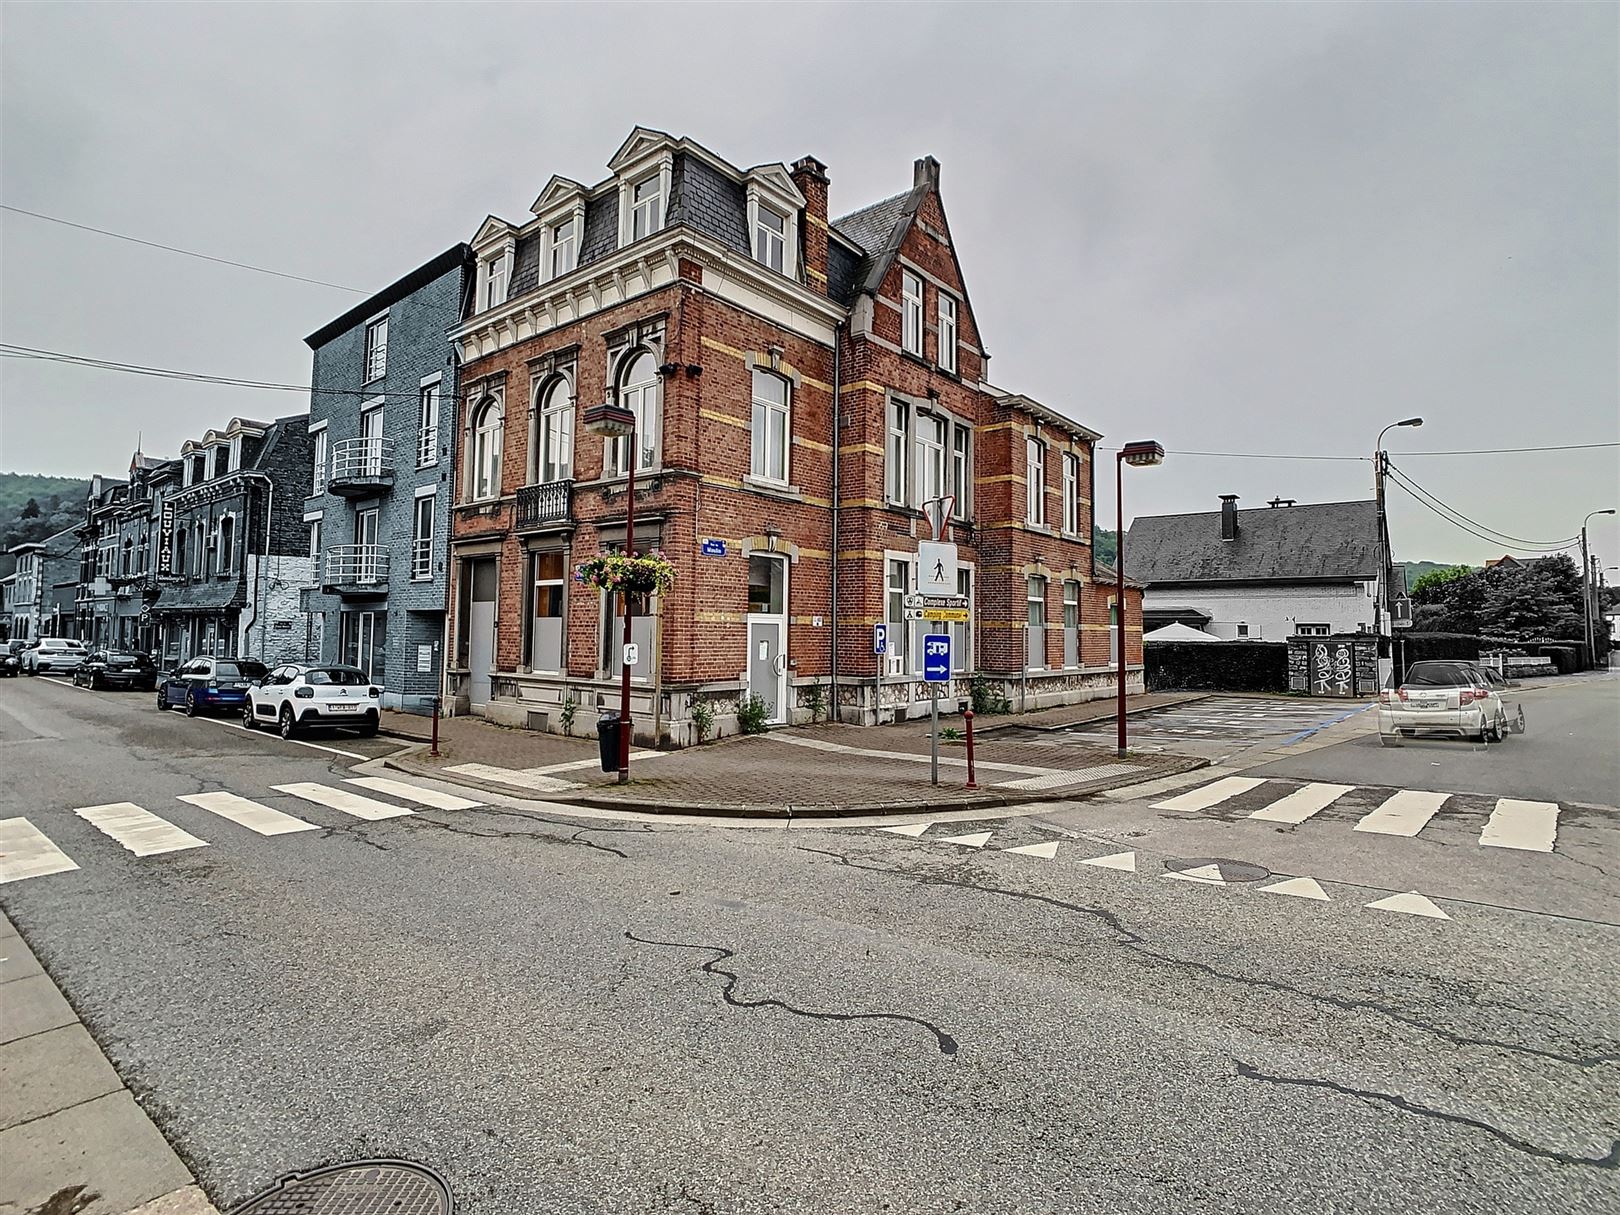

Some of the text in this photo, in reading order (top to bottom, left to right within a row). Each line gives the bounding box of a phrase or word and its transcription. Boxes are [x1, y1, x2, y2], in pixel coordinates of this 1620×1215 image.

[161, 502, 173, 571] LOUVIAUX
[924, 597, 946, 607] Complexe
[876, 628, 885, 649] P
